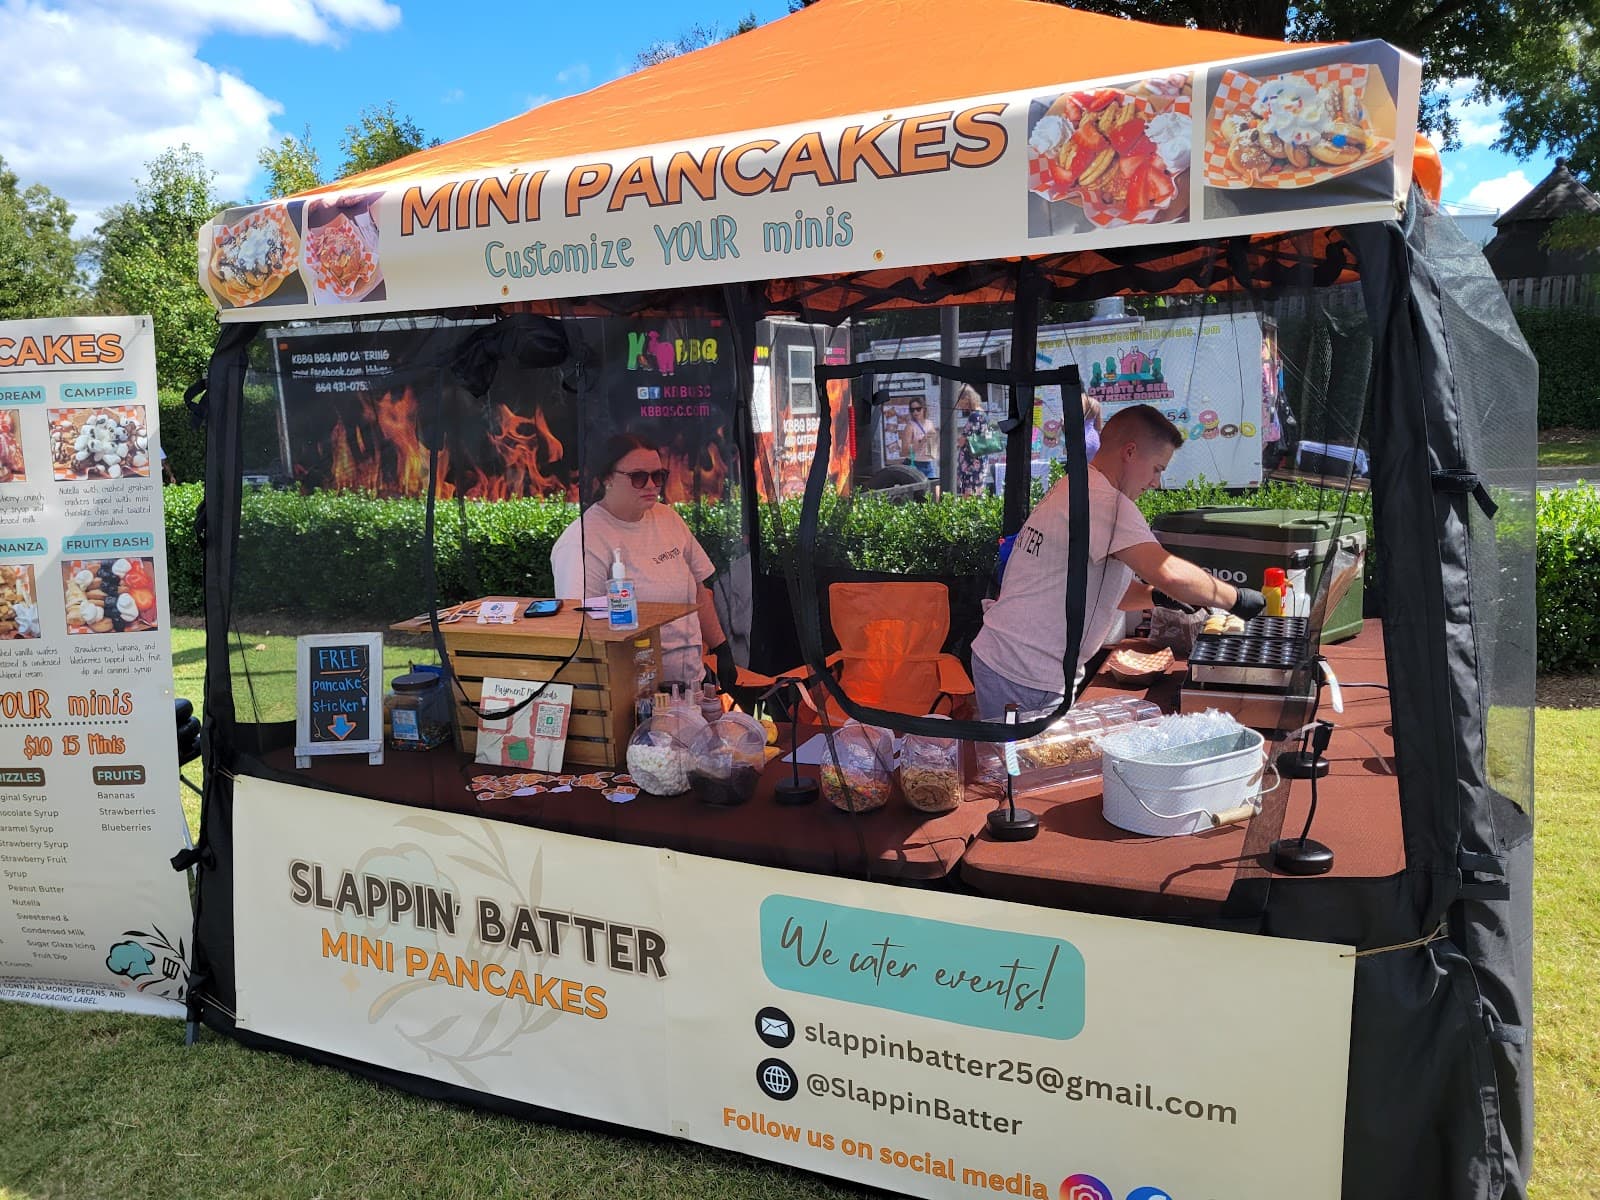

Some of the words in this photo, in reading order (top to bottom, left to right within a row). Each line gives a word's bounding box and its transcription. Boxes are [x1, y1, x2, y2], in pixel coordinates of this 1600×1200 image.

[400, 169, 549, 237] MINI
[564, 103, 1009, 217] PANCAKES
[485, 233, 635, 279] Customize
[653, 214, 739, 264] YOUR
[763, 206, 854, 254] minis
[314, 353, 332, 363] BBQ
[332, 351, 348, 362] AND
[350, 350, 390, 361] CAERING
[64, 386, 133, 398] CAMPFIRE
[806, 417, 821, 432] BB
[83, 485, 97, 494] with
[66, 540, 109, 550] FRUITY
[112, 537, 149, 548] BASH
[144, 641, 156, 650] and
[104, 656, 125, 665] topped
[128, 653, 145, 662] with
[319, 648, 359, 670] FREE
[93, 667, 103, 675] and
[312, 677, 362, 697] pancake
[495, 684, 526, 697] Payment
[527, 688, 559, 700] Mhods
[68, 688, 133, 718] minis
[23, 734, 53, 761] $10
[62, 735, 81, 755] 15
[87, 732, 126, 755] Minis
[0, 772, 41, 783] IZZLES
[97, 770, 142, 781] FRUITS
[22, 793, 47, 803] Syrup
[97, 791, 135, 799] Bananas
[34, 808, 59, 818] Syrup
[98, 807, 156, 816] Strawberries
[29, 825, 54, 834] Syrup
[101, 823, 152, 832] Blueberries
[43, 840, 69, 850] Syrup
[0, 855, 45, 864] Strawberry
[47, 856, 67, 864] Fruit
[3, 869, 28, 879] Syrup
[8, 884, 36, 893] Peanut
[38, 885, 64, 893] Butter
[12, 898, 41, 907] Nutella
[16, 912, 61, 921] Sweetened
[288, 859, 461, 936] SLAPPIN'
[477, 896, 670, 980] BATTER
[21, 926, 66, 935] Condensed
[26, 940, 49, 949] Sugar
[75, 942, 96, 951] Icing
[780, 914, 840, 969] We
[848, 936, 918, 987] cater
[934, 944, 1061, 1012] events!
[321, 927, 394, 973] MINI
[405, 946, 609, 1020] PANCAKES
[16, 990, 30, 998] PER
[31, 992, 72, 1002] PACKAGING
[73, 996, 97, 1004] LABEL
[37, 984, 74, 995] ALMONDS,
[77, 988, 107, 998] PECANS,
[804, 1021, 1238, 1126] slappinbatter25@gmail.com
[806, 1072, 1024, 1136] @SlappinBatter
[722, 1107, 801, 1144] Follow
[807, 1127, 836, 1151] us
[841, 1136, 874, 1161] on
[879, 1144, 956, 1183] social
[962, 1163, 1049, 1200] media
